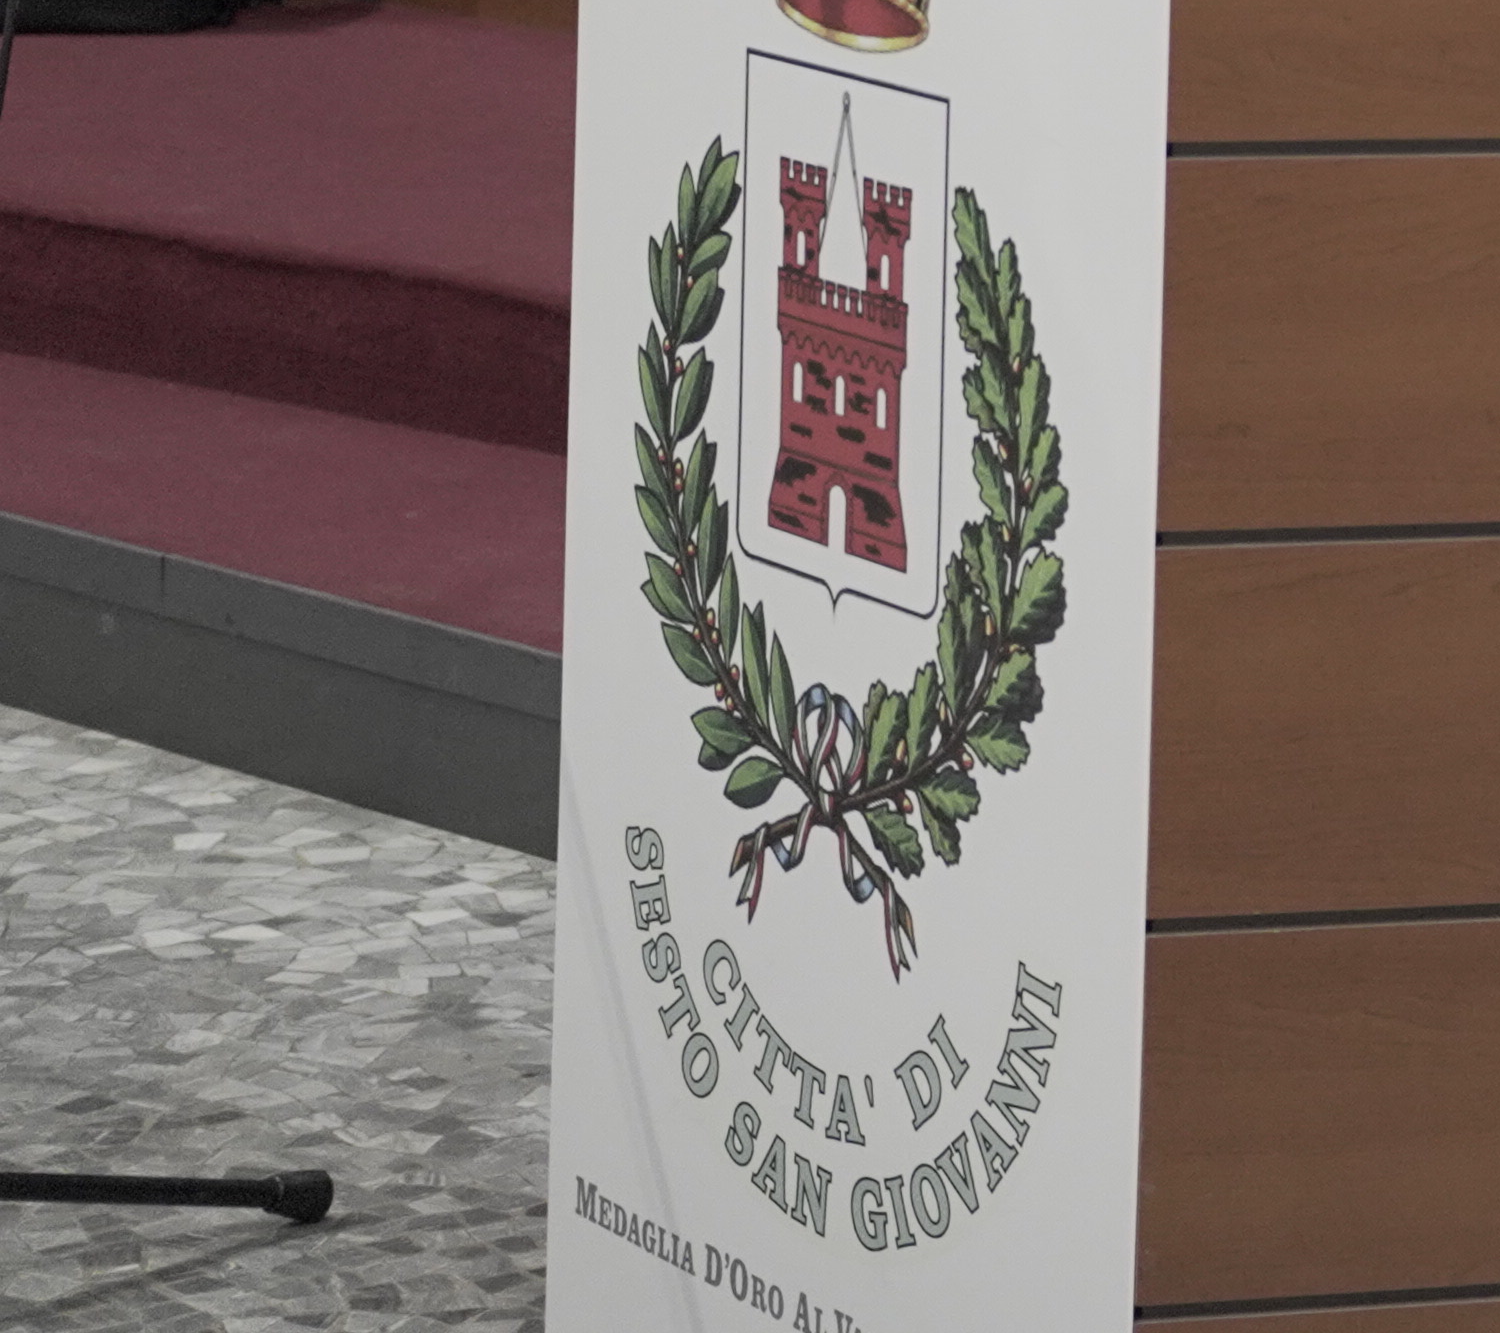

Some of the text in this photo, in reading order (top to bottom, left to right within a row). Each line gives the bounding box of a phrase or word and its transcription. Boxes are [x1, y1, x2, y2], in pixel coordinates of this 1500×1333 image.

[625, 825, 1063, 1251] SESTO SAN GIOVANNI
[702, 938, 970, 1147] CITTA' DI
[575, 1175, 696, 1277] MEDAGLIA
[704, 1243, 785, 1321] D'ORO
